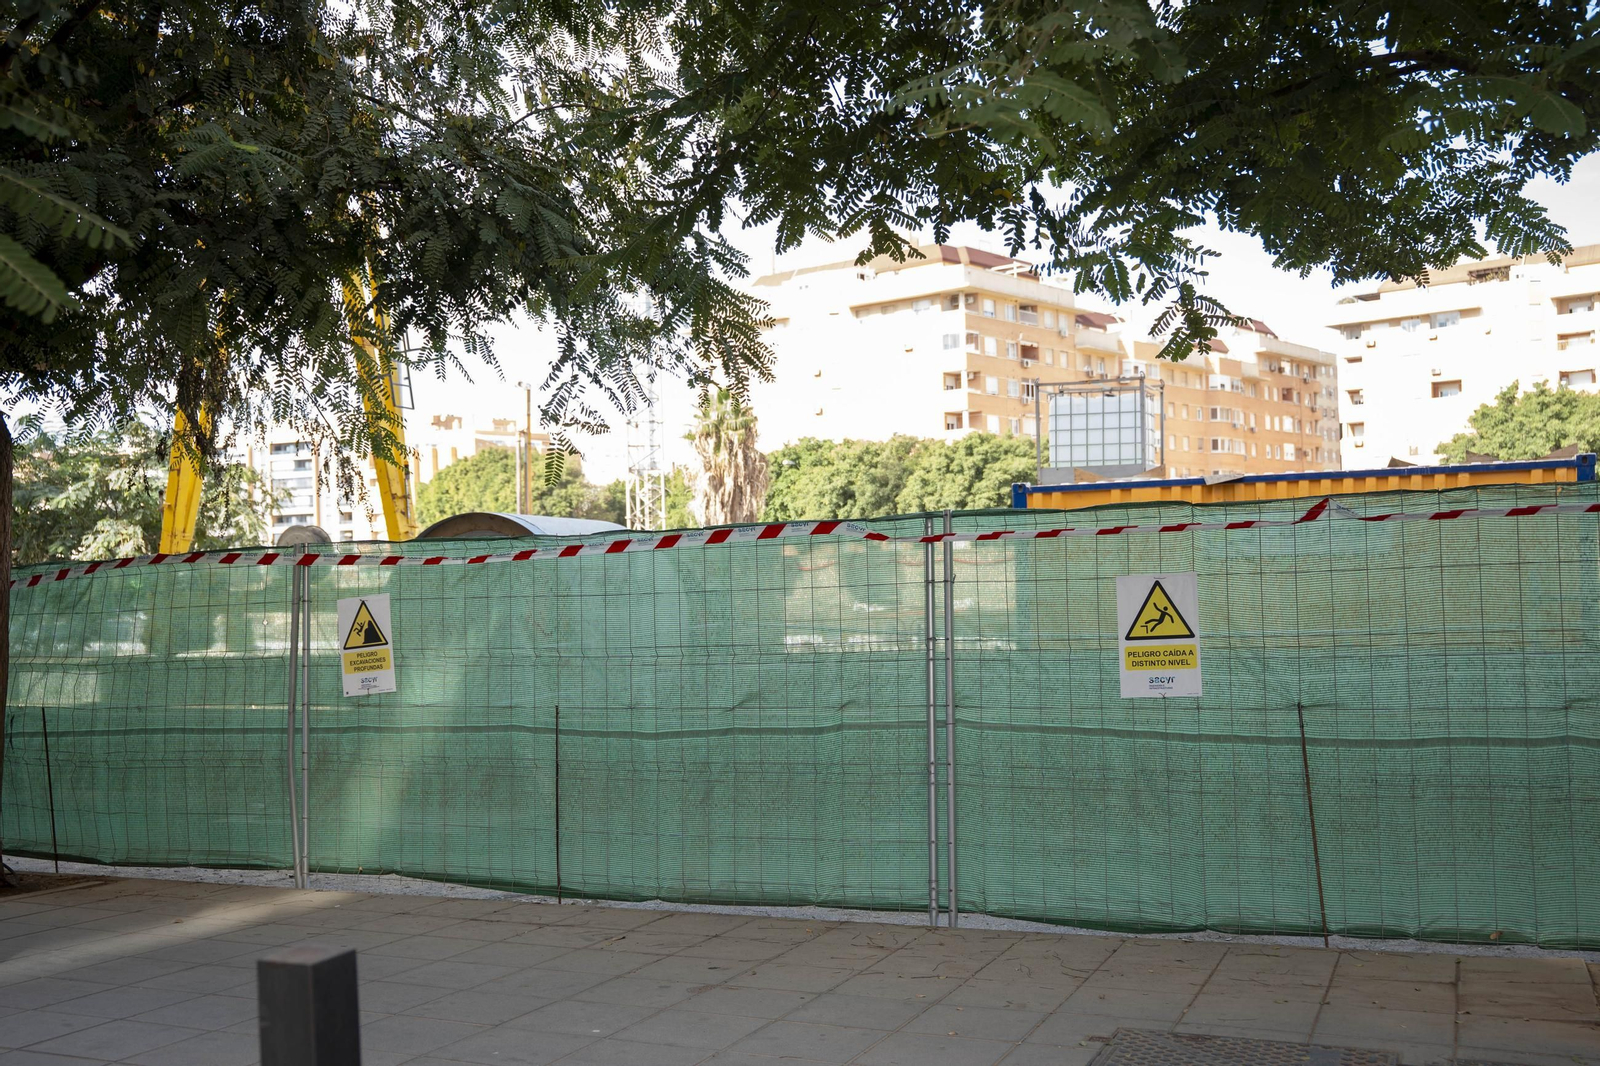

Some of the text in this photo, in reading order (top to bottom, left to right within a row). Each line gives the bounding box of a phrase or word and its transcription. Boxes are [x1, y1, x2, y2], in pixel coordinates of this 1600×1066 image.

[1128, 650, 1161, 658] PELIGRO
[1164, 648, 1186, 657] CAÍDA
[350, 657, 386, 666] EXCAVACIONES
[354, 664, 384, 672] PROFUNDAS
